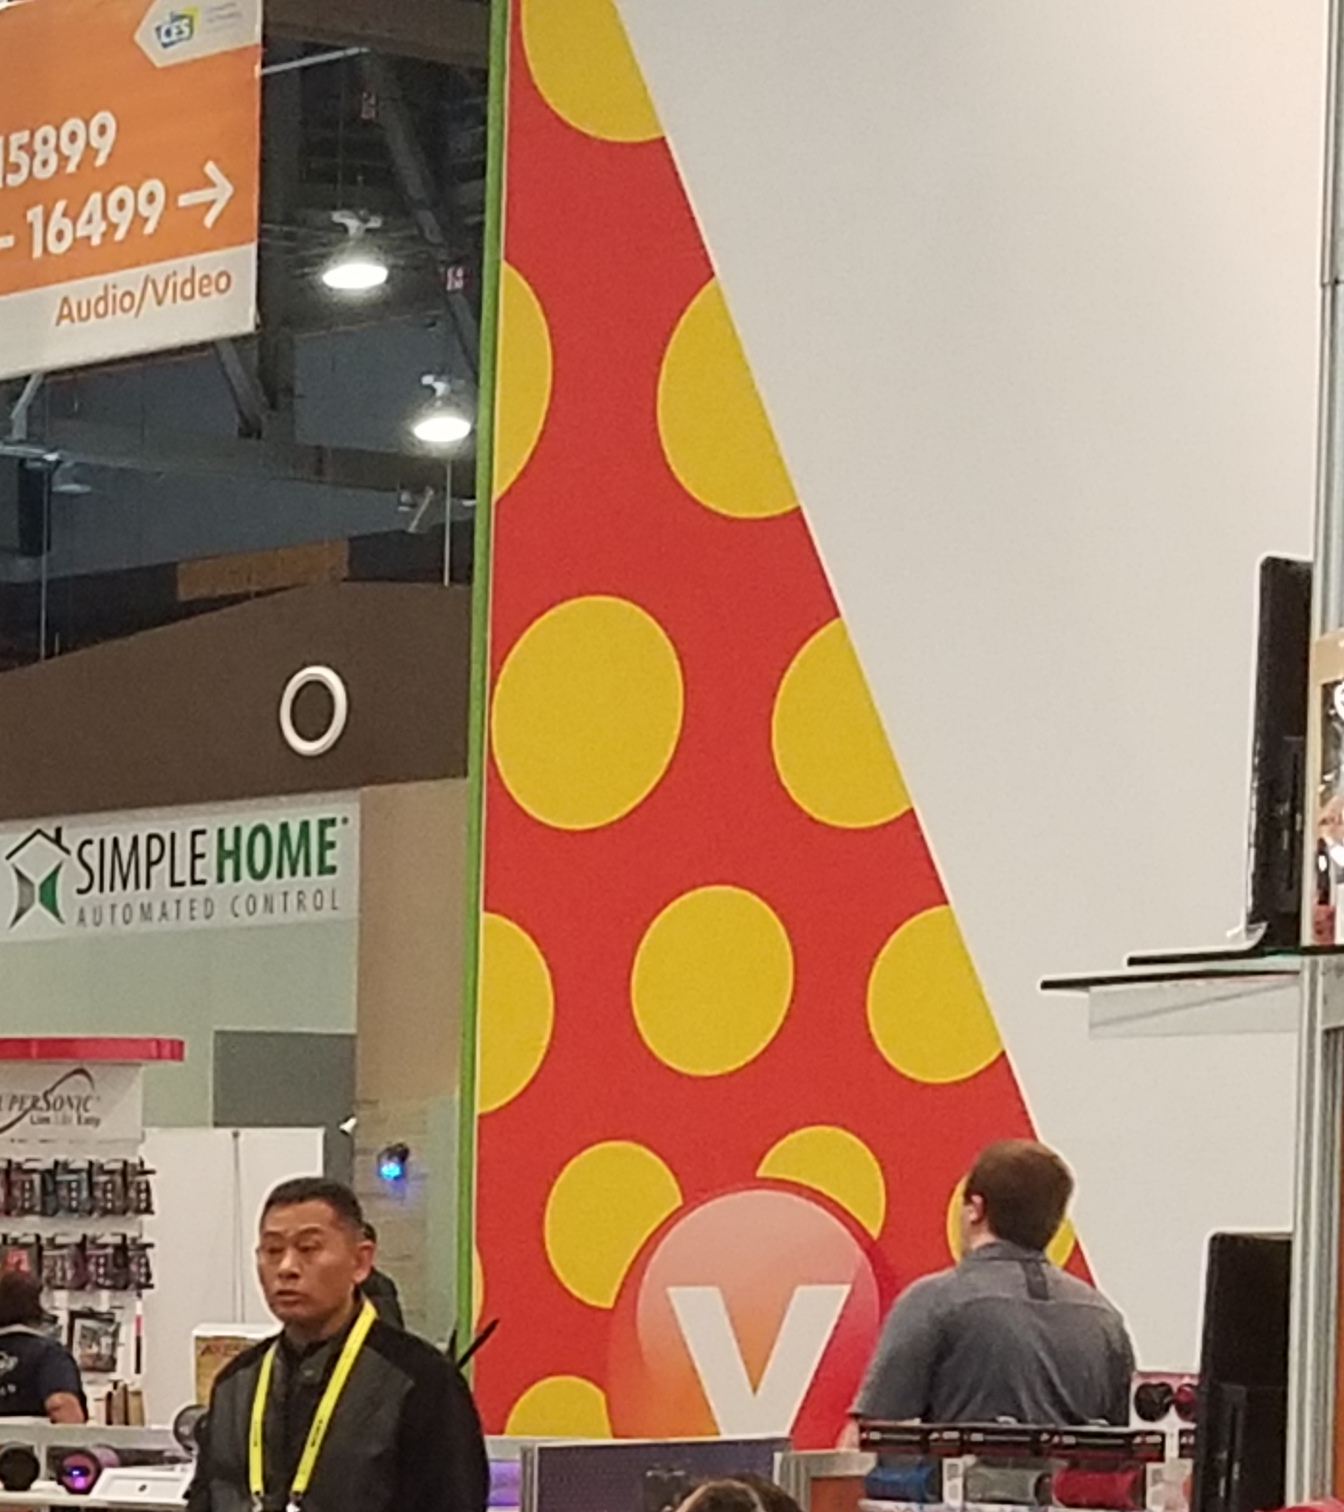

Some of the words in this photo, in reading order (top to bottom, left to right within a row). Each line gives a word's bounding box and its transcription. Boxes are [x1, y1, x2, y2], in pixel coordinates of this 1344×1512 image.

[158, 17, 191, 46] CES
[26, 178, 166, 260] 16499
[55, 265, 232, 327] Audio/Video
[75, 896, 215, 929] AUTOMATED
[230, 889, 340, 918] CONTROL
[666, 1284, 852, 1437] V
